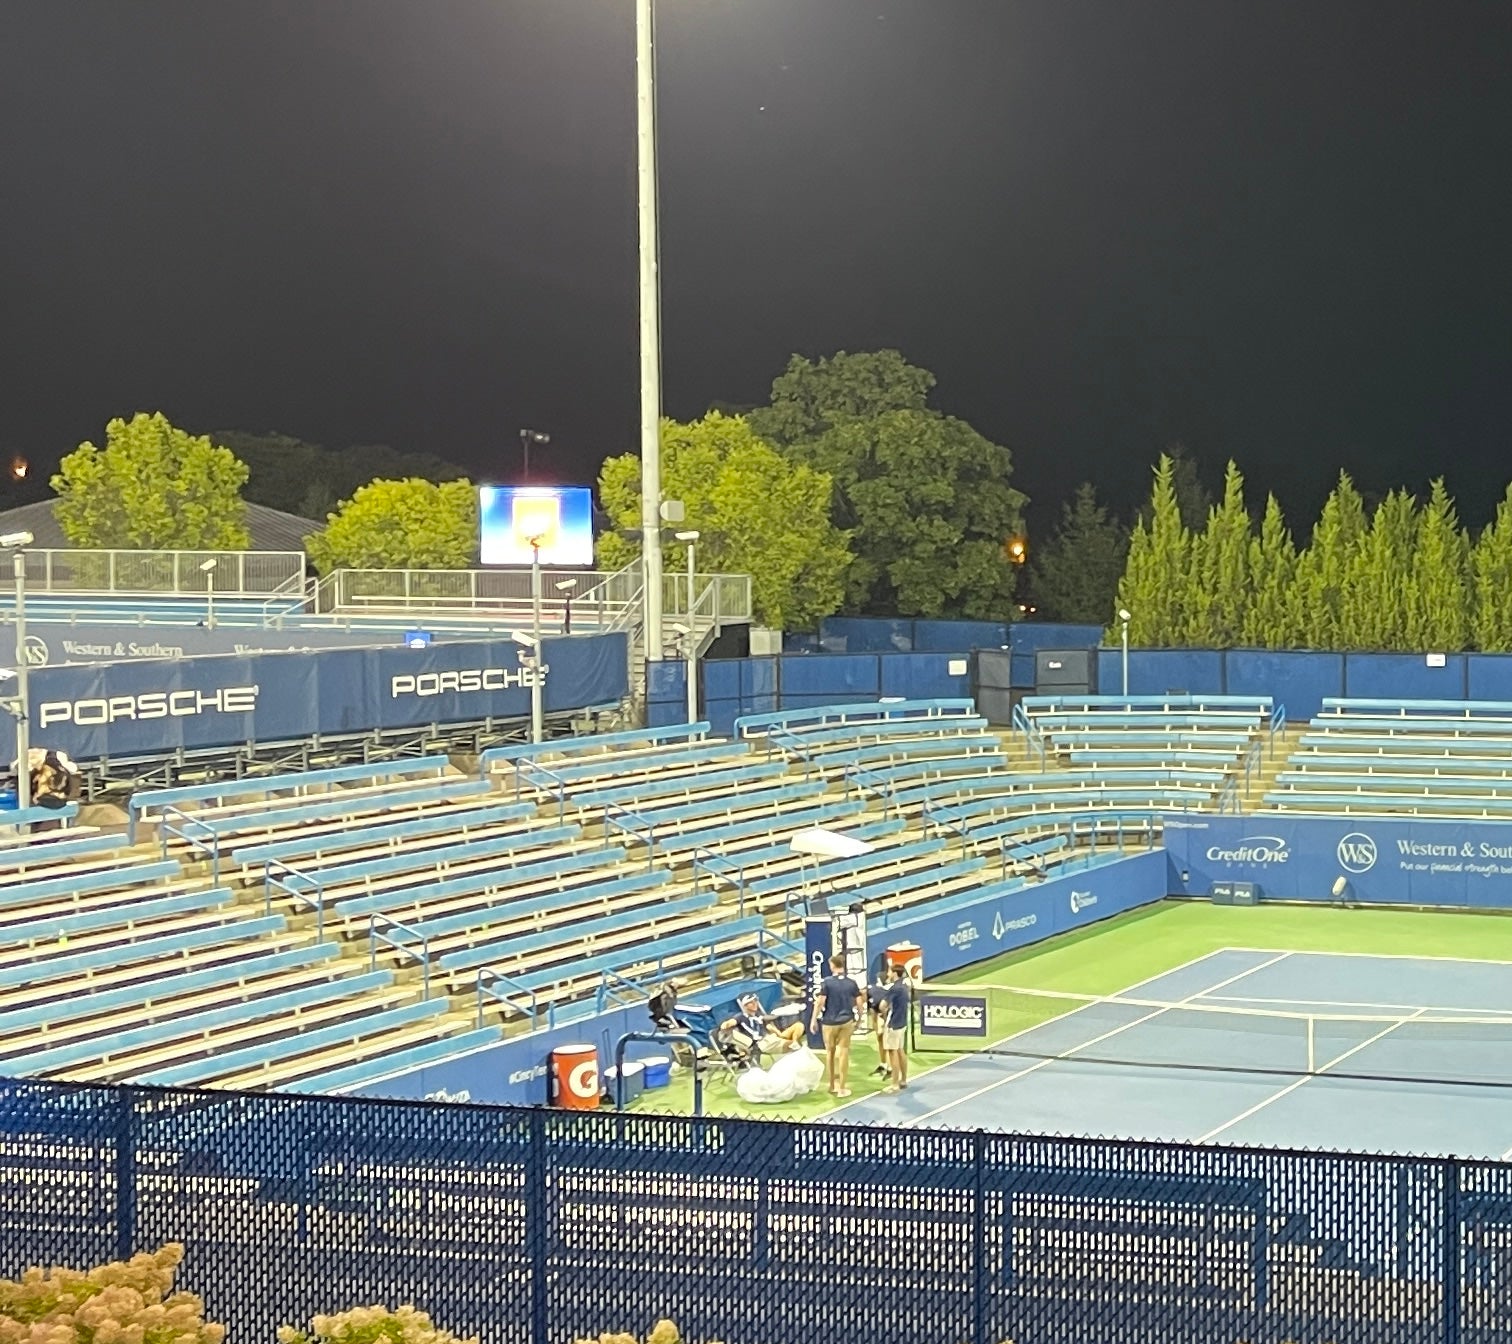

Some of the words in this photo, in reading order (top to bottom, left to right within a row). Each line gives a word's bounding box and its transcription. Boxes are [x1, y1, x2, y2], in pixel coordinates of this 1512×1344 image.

[63, 640, 111, 656] Western
[113, 642, 126, 657] &
[129, 641, 183, 658] Southern
[392, 667, 546, 698] PORSCHE
[39, 687, 257, 729] PORSCHE
[1206, 846, 1290, 863] CreditOne
[1396, 839, 1457, 857] Western
[1460, 841, 1475, 858] &
[923, 1005, 983, 1019] HOLOGIC
[569, 1060, 599, 1098] G
